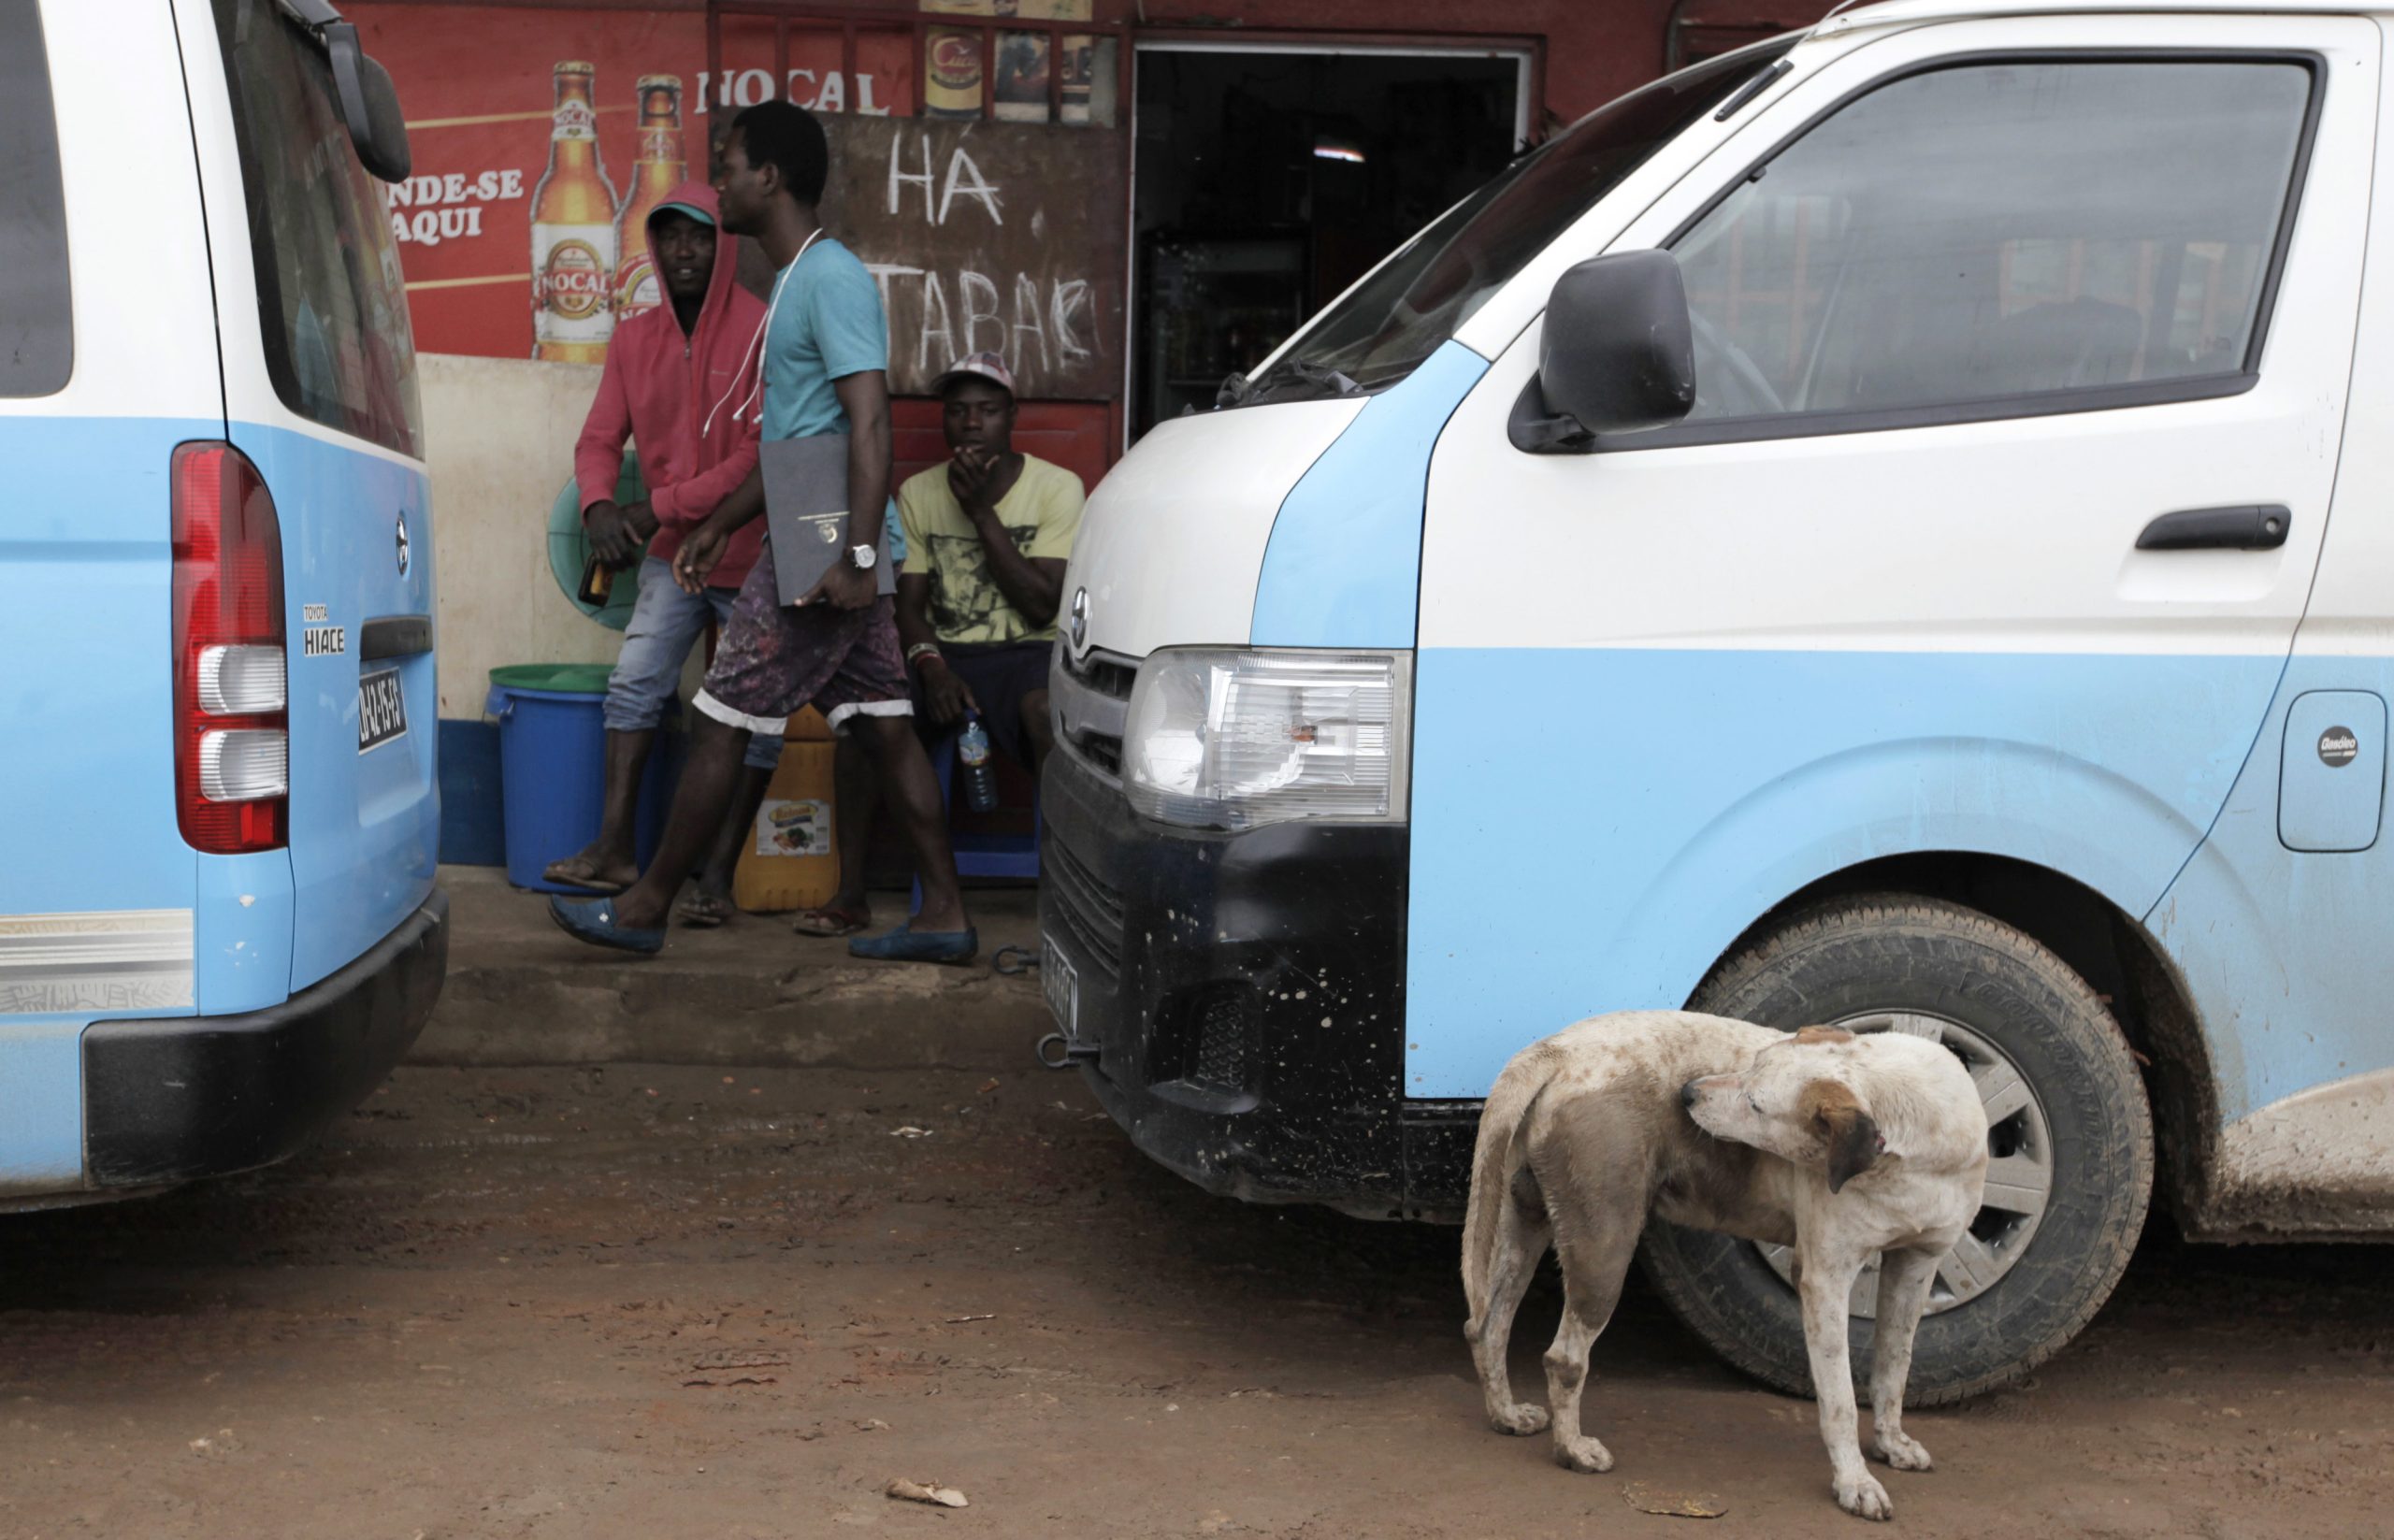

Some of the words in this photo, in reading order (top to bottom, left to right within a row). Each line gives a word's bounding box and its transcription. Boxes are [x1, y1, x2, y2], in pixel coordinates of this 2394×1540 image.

[694, 68, 892, 116] NOCAL
[392, 207, 483, 246] AQUI
[541, 271, 610, 296] NOCAL
[304, 606, 327, 620] TOYOTA
[304, 627, 344, 655] HIACE
